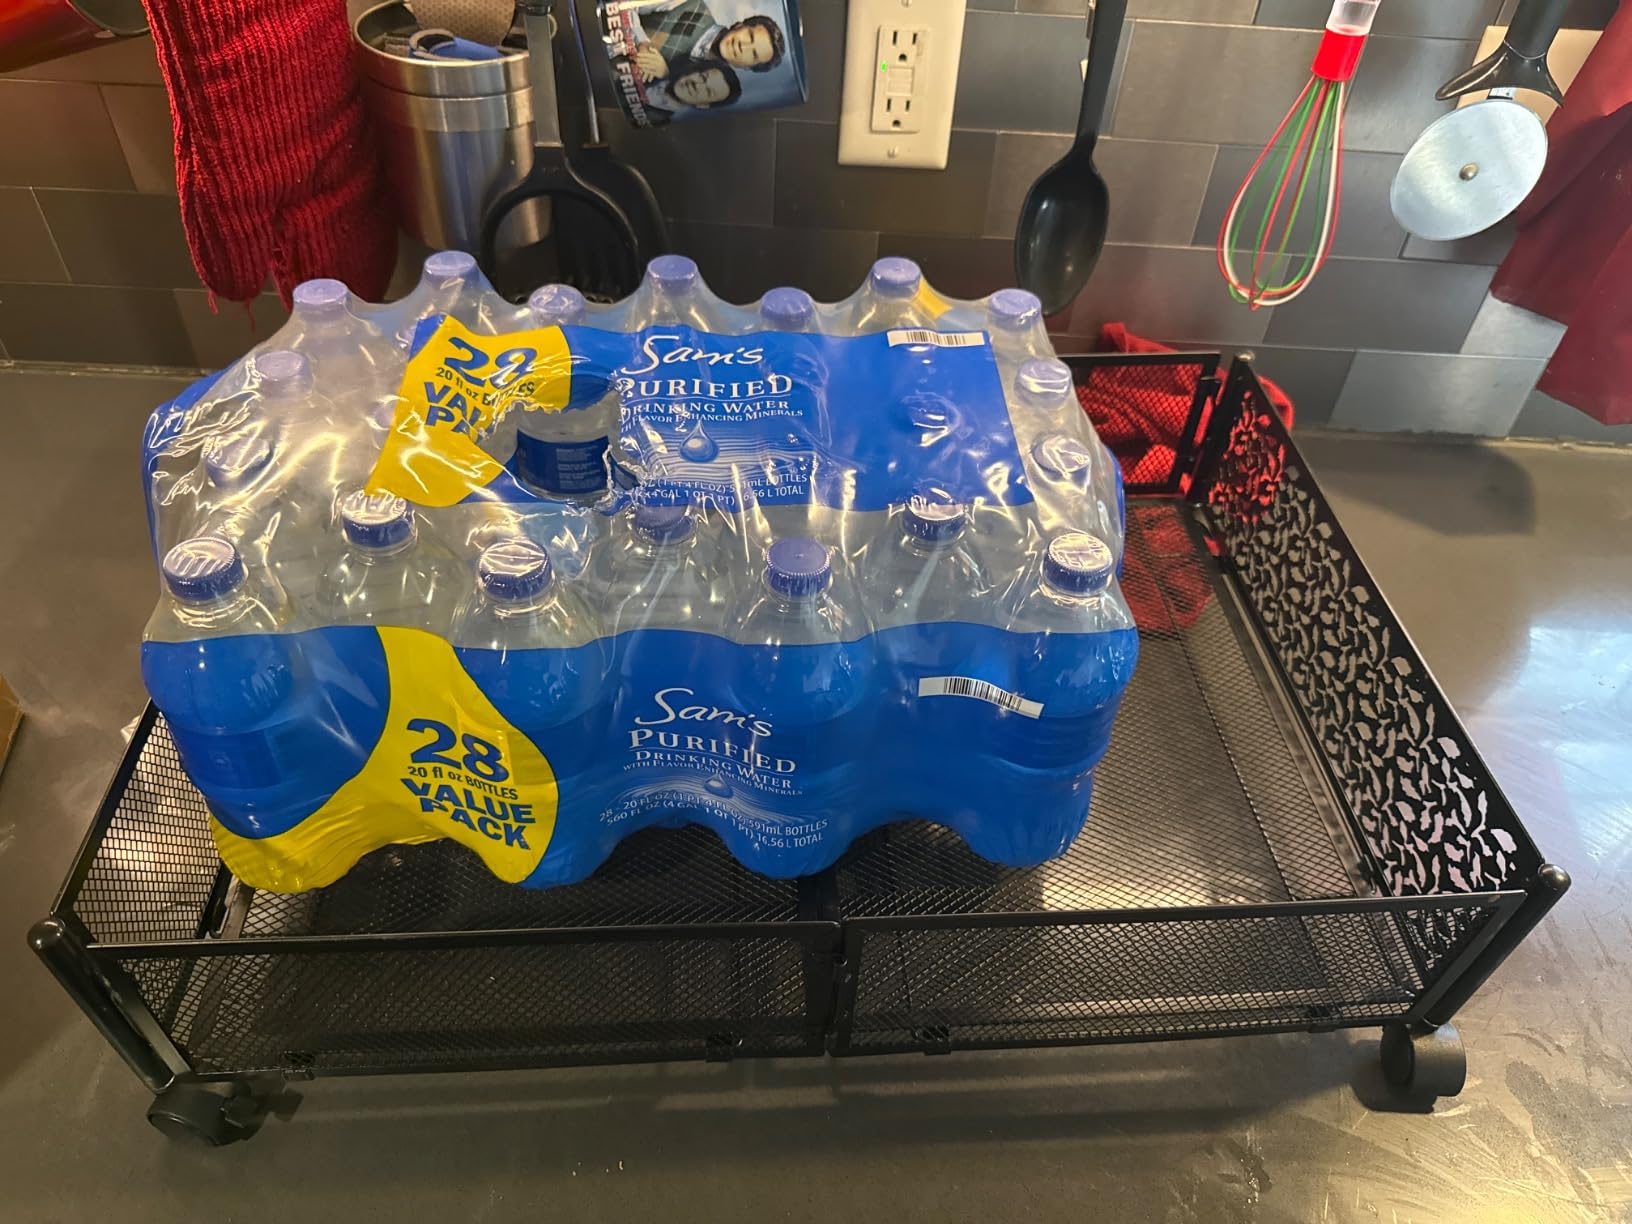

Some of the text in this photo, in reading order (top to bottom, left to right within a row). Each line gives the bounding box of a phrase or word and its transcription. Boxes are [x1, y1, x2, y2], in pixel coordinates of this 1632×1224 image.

[606, 2, 627, 57] BEST
[616, 61, 650, 126] FRIENDS
[443, 336, 538, 391] 28
[620, 335, 764, 375] Sam's
[435, 367, 453, 381] 20
[465, 387, 479, 400] oz
[616, 373, 793, 399] PURIFIED
[423, 381, 488, 429] VAL
[619, 400, 790, 426] DRINKING WATER
[632, 414, 673, 427] FLAVOR
[745, 409, 804, 422] MINERALS
[660, 489, 681, 498] GAL
[717, 495, 736, 506] PT)
[767, 490, 773, 499] L
[775, 485, 805, 497] TOTAL
[694, 481, 706, 490] FL
[708, 483, 727, 494] OZ)
[729, 480, 763, 493] 51mL
[634, 687, 774, 737] Sam's
[406, 717, 510, 783] 28
[628, 728, 797, 774] PURIFIED
[635, 750, 793, 789] DRINKING WATER
[407, 766, 428, 778] 20
[447, 771, 463, 783] oz
[465, 775, 519, 801] BOTTLES
[623, 759, 803, 796] WITH FLAVOR ENHANCING MINERALS
[400, 778, 536, 824] VALUE
[623, 800, 638, 810] 20
[640, 797, 650, 806] FL
[748, 820, 783, 836] 591mL
[785, 818, 829, 837] BOTTLES
[420, 797, 532, 851] PACK
[606, 811, 628, 826] 560
[630, 808, 641, 817] FL
[645, 800, 661, 810] OZ
[757, 832, 785, 849] 16.56
[786, 838, 792, 849] L
[793, 831, 824, 848] TOTAL
